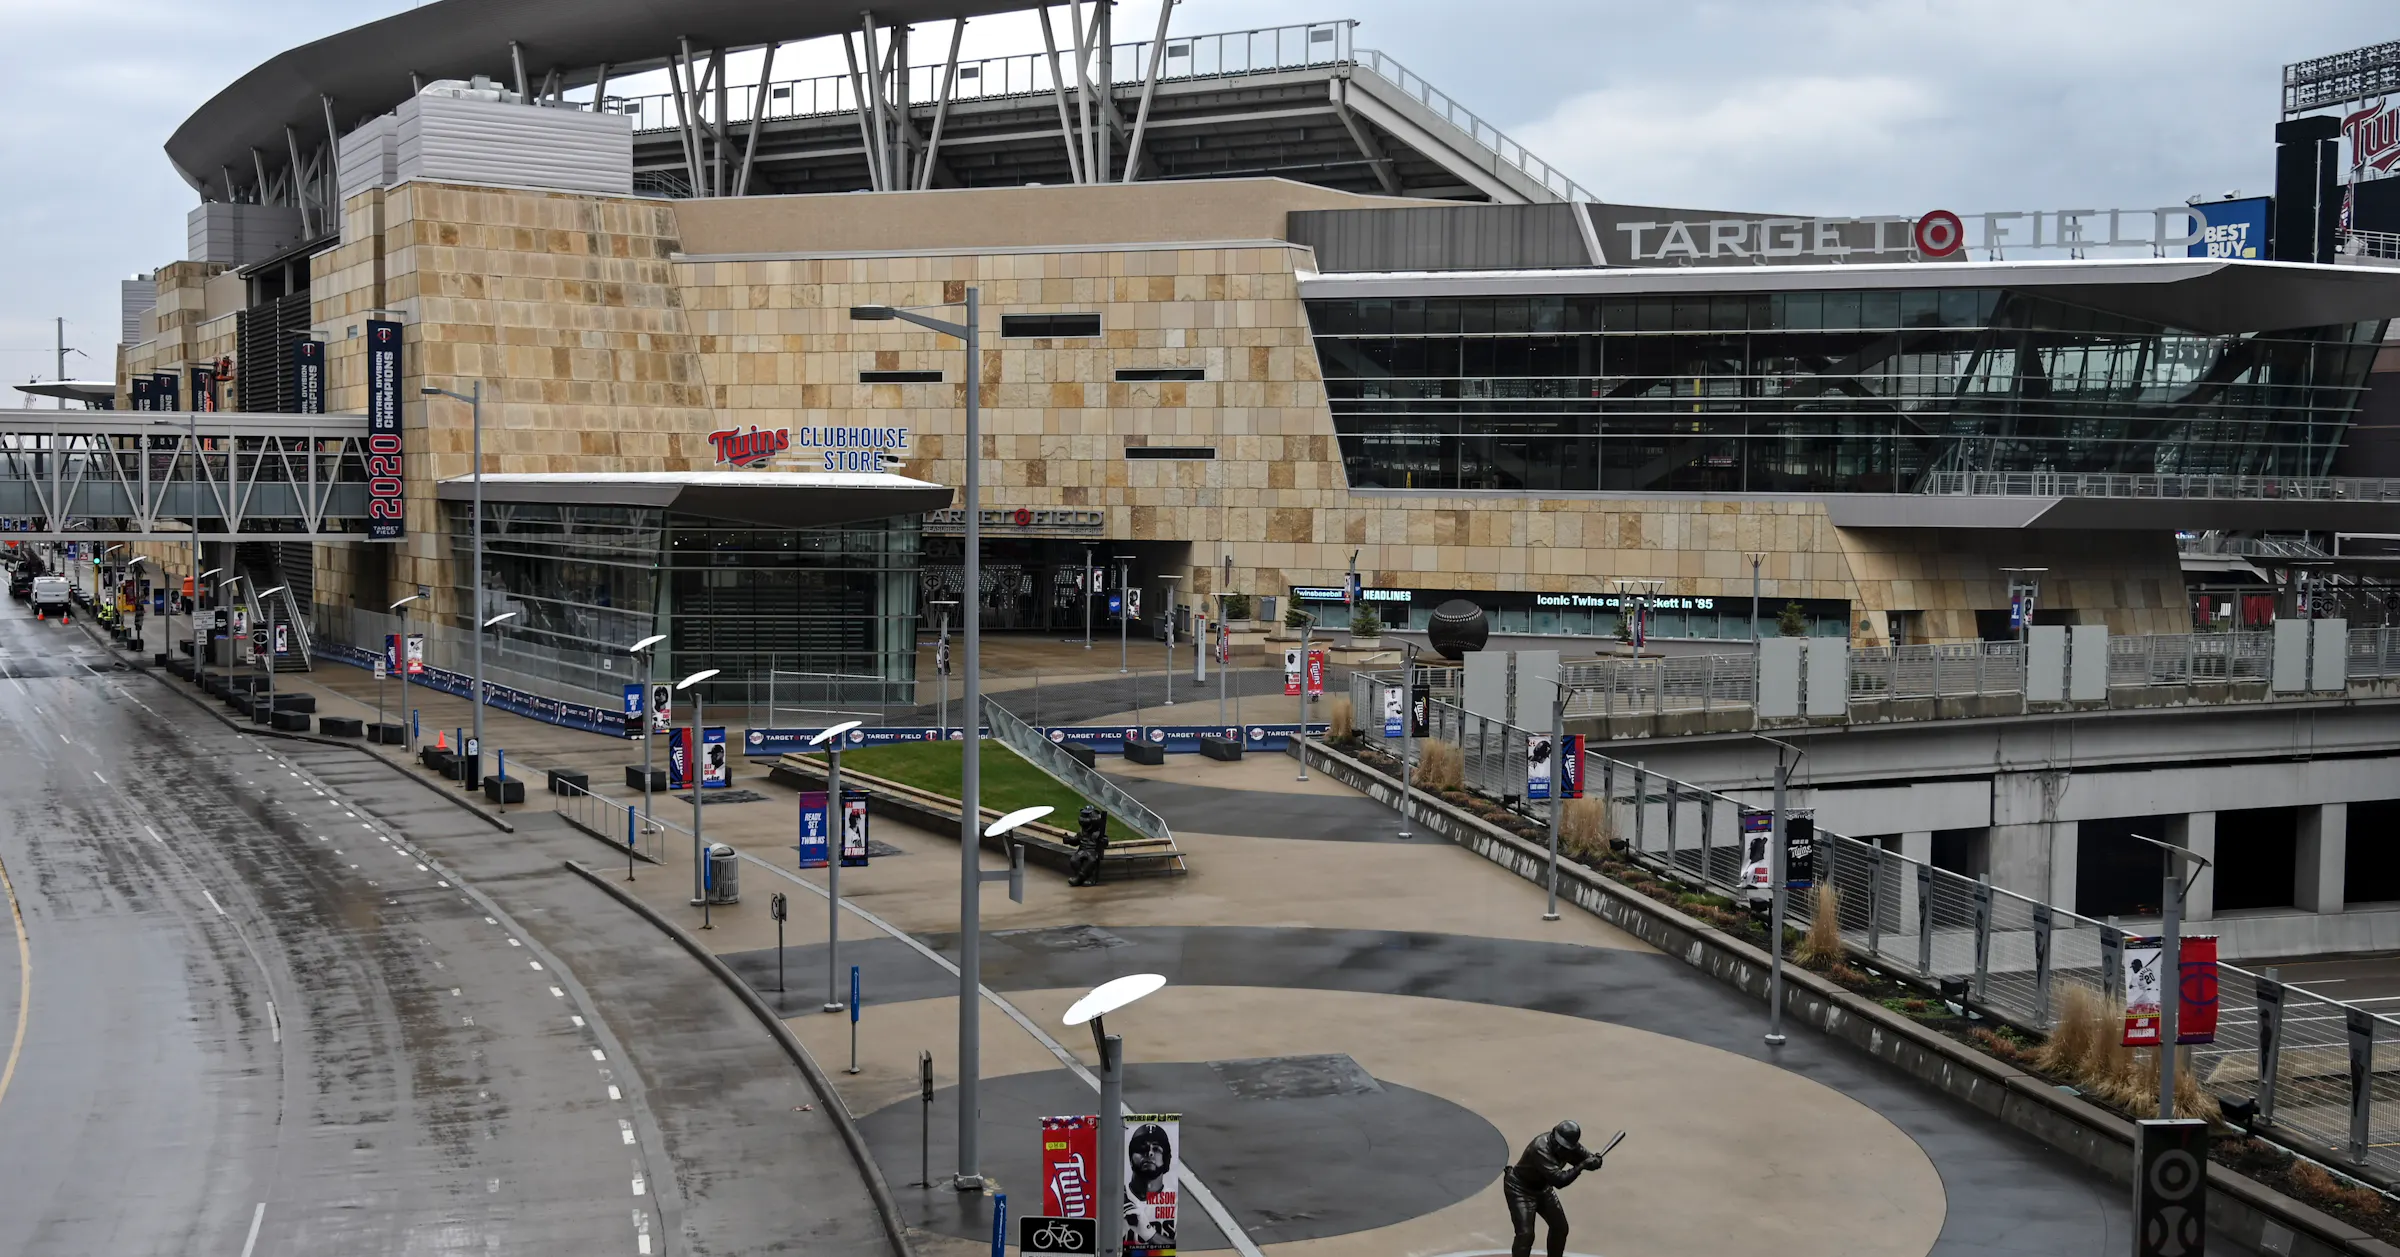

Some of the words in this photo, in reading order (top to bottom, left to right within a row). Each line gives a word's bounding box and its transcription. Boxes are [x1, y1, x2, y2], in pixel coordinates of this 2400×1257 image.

[1616, 215, 1901, 260] TARGET
[1984, 207, 2208, 250] FIELD
[2204, 222, 2250, 243] BEST
[2207, 239, 2246, 258] BUY
[375, 351, 383, 389] DIVISION
[384, 351, 394, 428] CHAMPIONS
[375, 390, 383, 428] CENTRAL
[707, 425, 790, 468] Twins
[800, 427, 908, 448] CLUBHOUSE
[824, 451, 884, 471] STORE
[369, 433, 402, 519] 2020
[1034, 511, 1105, 525] FIELD
[1363, 590, 1412, 602] HEADLINES
[1572, 595, 1603, 607] Twins
[1682, 598, 1692, 609] in
[1695, 599, 1714, 609] '85
[1310, 660, 1321, 685] Twins
[1787, 844, 1813, 859] Twins
[2144, 972, 2156, 985] 20
[1051, 1152, 1090, 1217] Twin
[1146, 1192, 1176, 1205] NELSON
[1155, 1206, 1175, 1219] CRUZ
